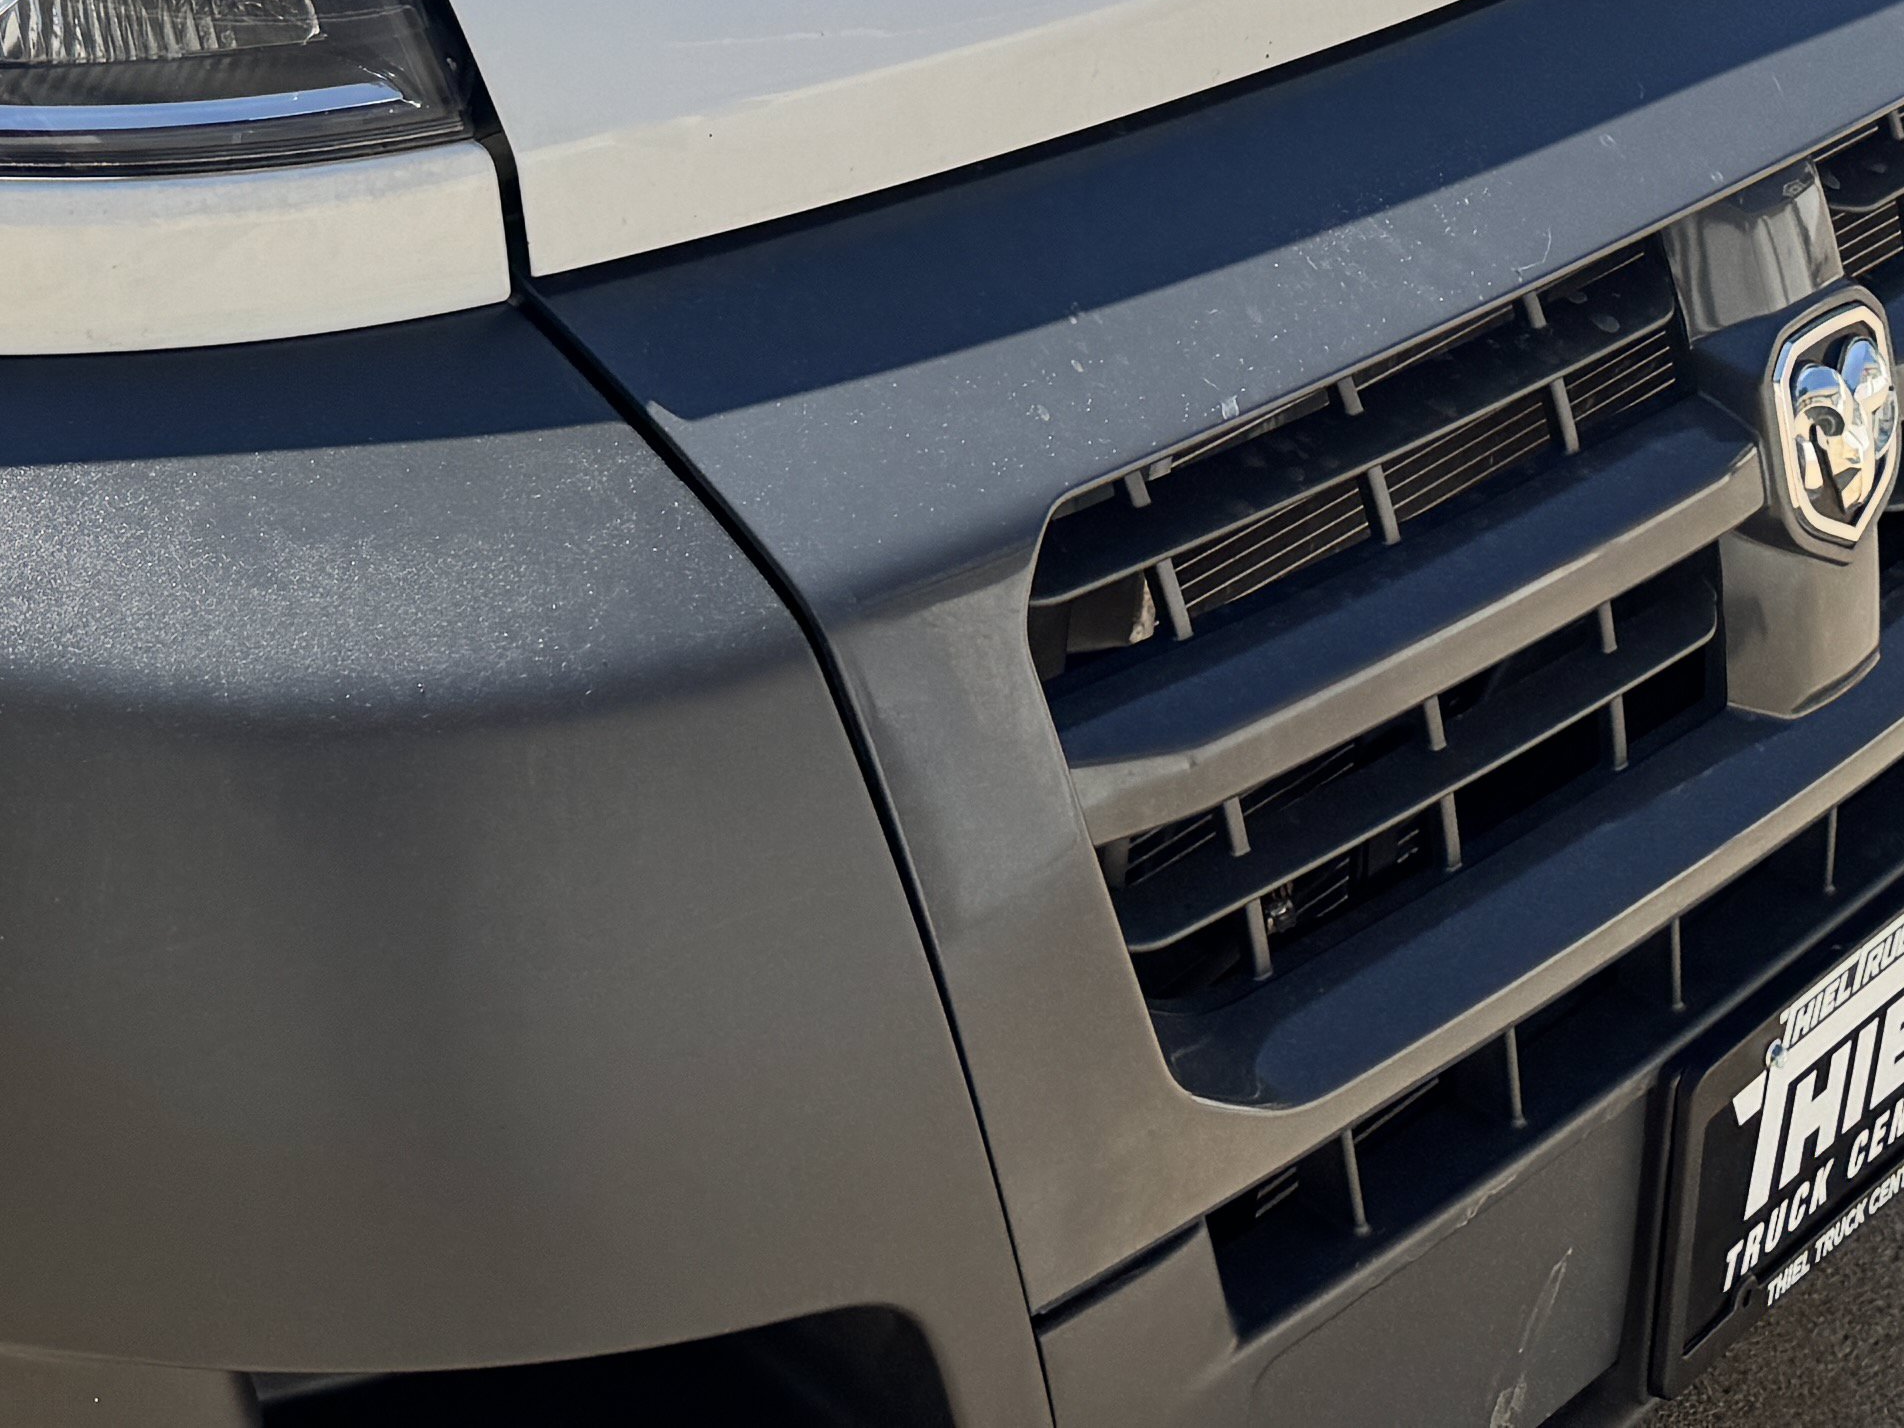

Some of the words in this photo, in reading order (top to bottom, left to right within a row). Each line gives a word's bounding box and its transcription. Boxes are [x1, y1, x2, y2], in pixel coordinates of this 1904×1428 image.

[1723, 1157, 1835, 1293] TRUCK
[1767, 1249, 1811, 1307] THIEL
[1814, 1198, 1868, 1263] TRUCK
